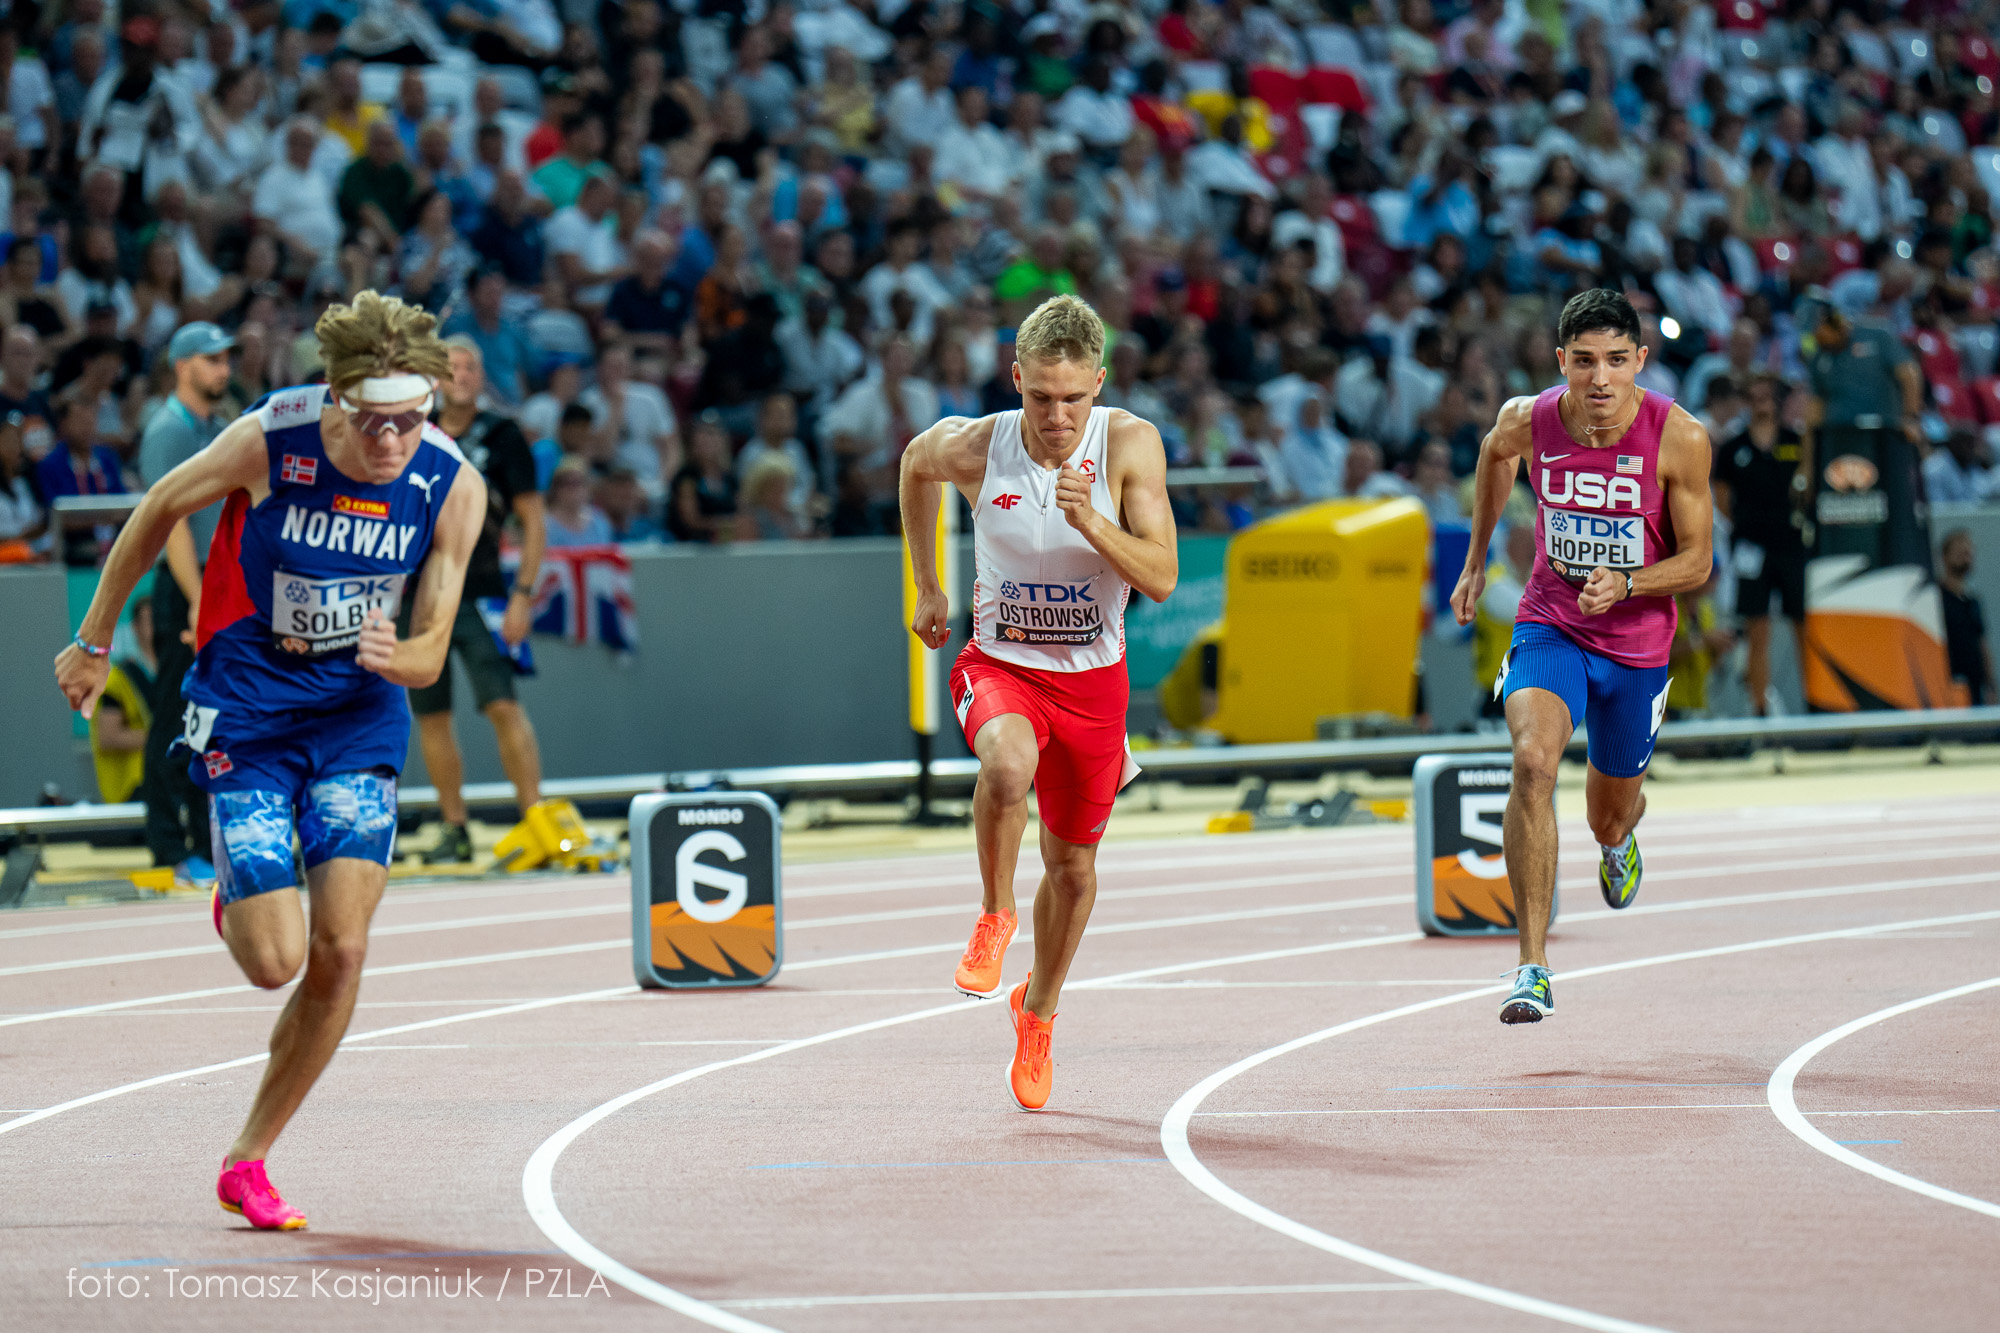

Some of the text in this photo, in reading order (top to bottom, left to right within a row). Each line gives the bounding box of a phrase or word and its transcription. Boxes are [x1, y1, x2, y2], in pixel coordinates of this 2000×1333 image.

[991, 493, 1022, 510] 4F
[1541, 468, 1641, 510] USA
[351, 501, 387, 515] EXTRA
[281, 504, 417, 562] NORWAY
[1568, 514, 1636, 539] TDK
[1551, 535, 1635, 565] HOPPEL
[1569, 567, 1592, 577] BUD
[309, 578, 393, 606] TDK
[1019, 582, 1095, 603] TDK
[1000, 602, 1100, 628] OSTROWSKI
[1029, 632, 1088, 642] BUDAPEST
[190, 706, 200, 736] 6
[677, 808, 744, 825] MONDO
[1456, 793, 1510, 880] 5
[675, 829, 749, 924] 6
